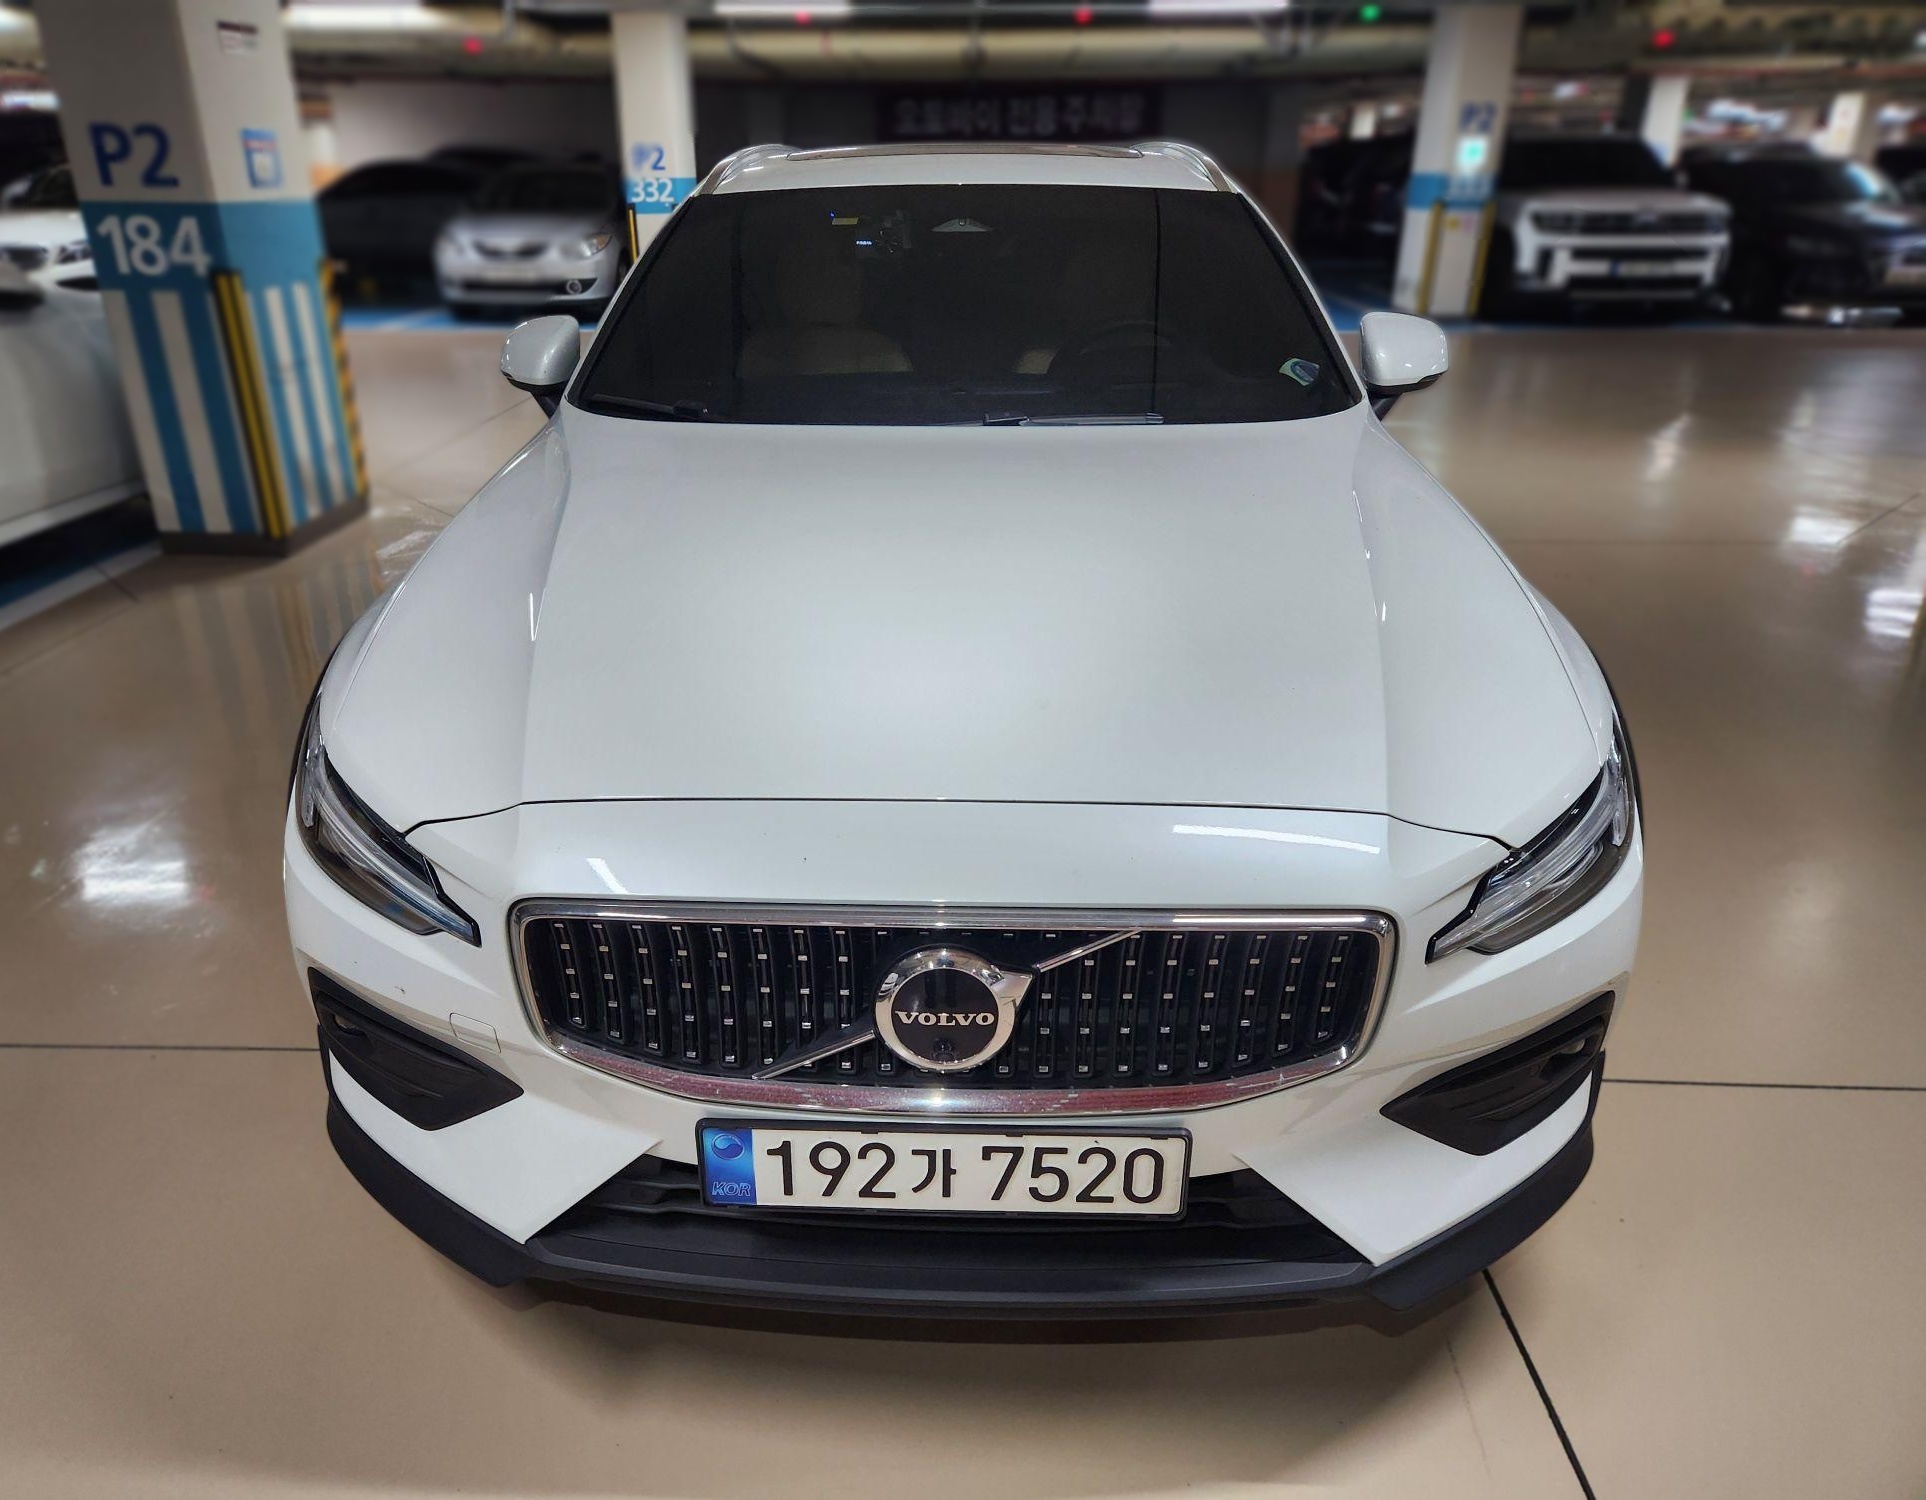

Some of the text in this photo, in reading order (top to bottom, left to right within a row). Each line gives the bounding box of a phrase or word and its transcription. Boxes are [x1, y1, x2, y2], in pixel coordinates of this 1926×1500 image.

[88, 122, 180, 188] P2
[631, 178, 675, 203] 332
[97, 214, 212, 277] 184
[895, 1010, 995, 1026] VOLVO
[712, 1181, 751, 1197] KOR
[766, 1139, 1166, 1204] 192가 7520
